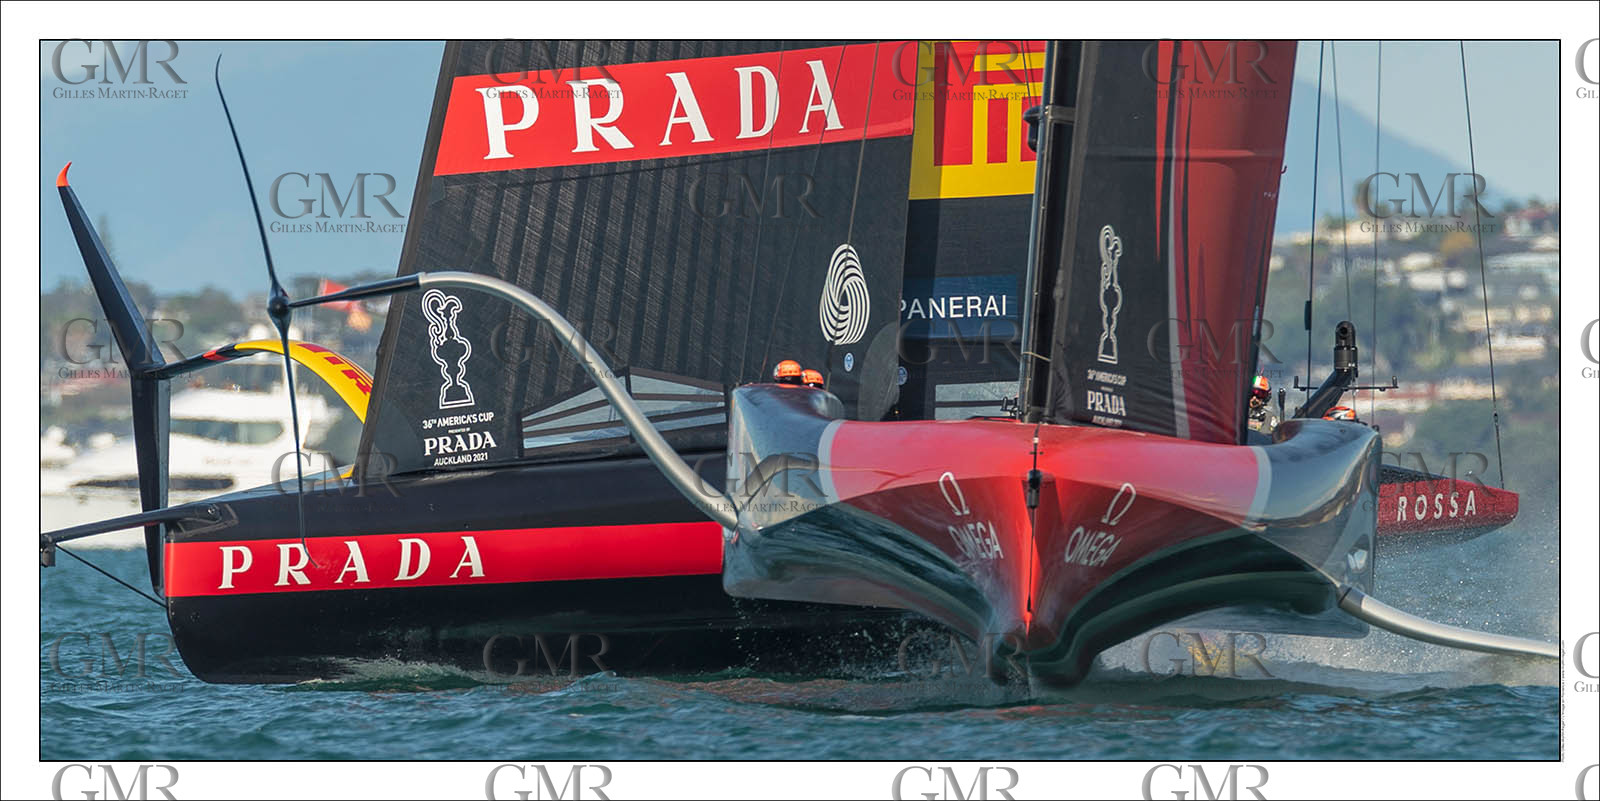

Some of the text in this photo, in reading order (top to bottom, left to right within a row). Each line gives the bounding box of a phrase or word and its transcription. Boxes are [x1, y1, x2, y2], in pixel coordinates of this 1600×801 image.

[476, 59, 845, 160] PRADA
[478, 412, 494, 422] CUP
[1088, 390, 1126, 416] PRADA
[424, 431, 497, 456] PRADA
[434, 452, 488, 466] AUCKLAND 2021
[1397, 489, 1477, 521] ROSSA
[948, 520, 1004, 560] OMEGA
[1064, 526, 1122, 567] OMEGA
[218, 535, 486, 589] PRADA
